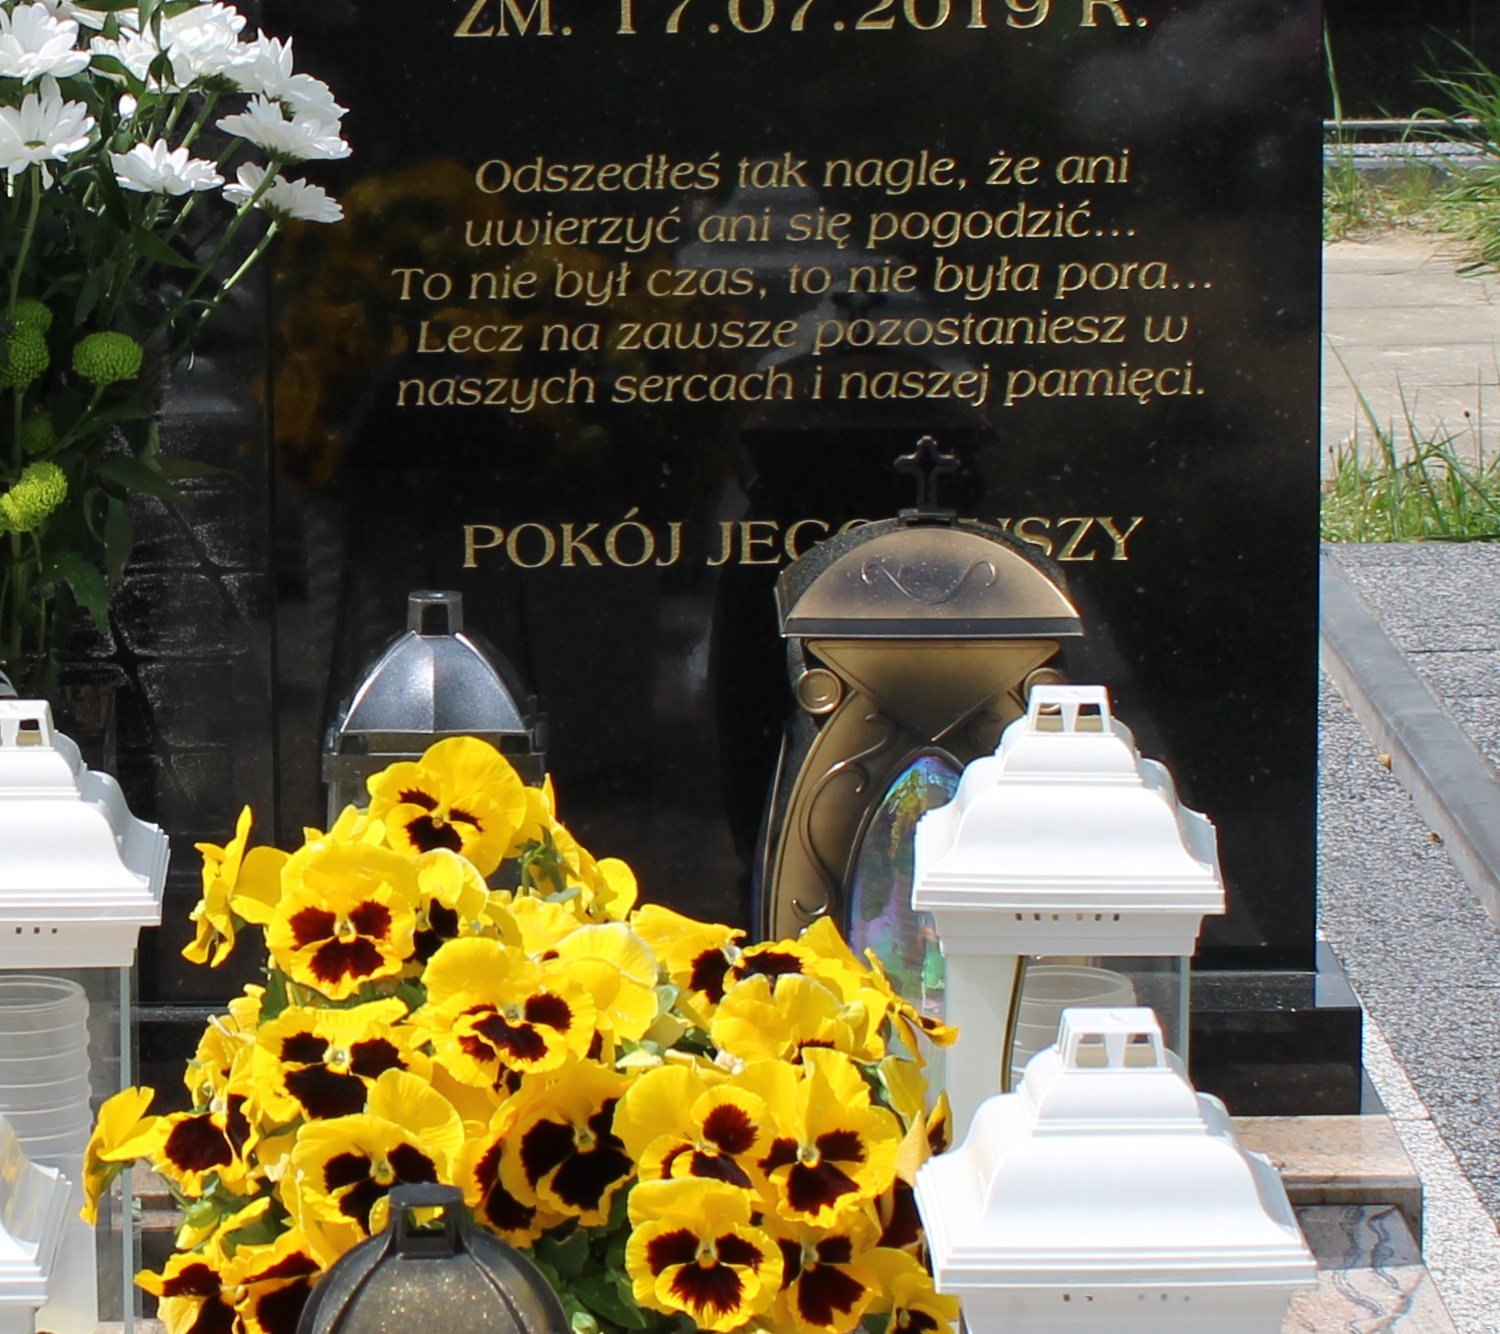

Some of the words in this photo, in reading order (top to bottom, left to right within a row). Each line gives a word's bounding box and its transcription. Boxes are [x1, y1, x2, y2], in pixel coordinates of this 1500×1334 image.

[475, 151, 720, 194] Odszedłeś
[738, 151, 808, 189] tak
[822, 149, 967, 196] nagle,
[985, 150, 1041, 185] że
[1056, 148, 1130, 185] ani
[465, 205, 681, 253] uwierzyć
[698, 207, 771, 243] ani
[785, 206, 852, 250] się
[866, 199, 1135, 249] pogodzić...
[391, 268, 453, 301] To
[468, 264, 538, 300] nie
[555, 261, 631, 307] był
[647, 267, 767, 299] czas,
[789, 264, 832, 294] to
[847, 258, 918, 293] nie
[934, 255, 1040, 301] była
[1054, 261, 1212, 300] pora...
[417, 320, 524, 353] Lecz
[539, 323, 600, 351] na
[616, 320, 799, 350] zawsze
[812, 309, 1126, 356] pozostaniesz
[1144, 316, 1189, 343] w
[396, 367, 595, 414] naszych
[611, 364, 794, 404] sercach
[811, 365, 823, 400] i
[838, 363, 990, 407] naszej
[1003, 360, 1205, 407] pamięci.
[462, 506, 683, 569] POKÓJ
[706, 517, 872, 566] JEG
